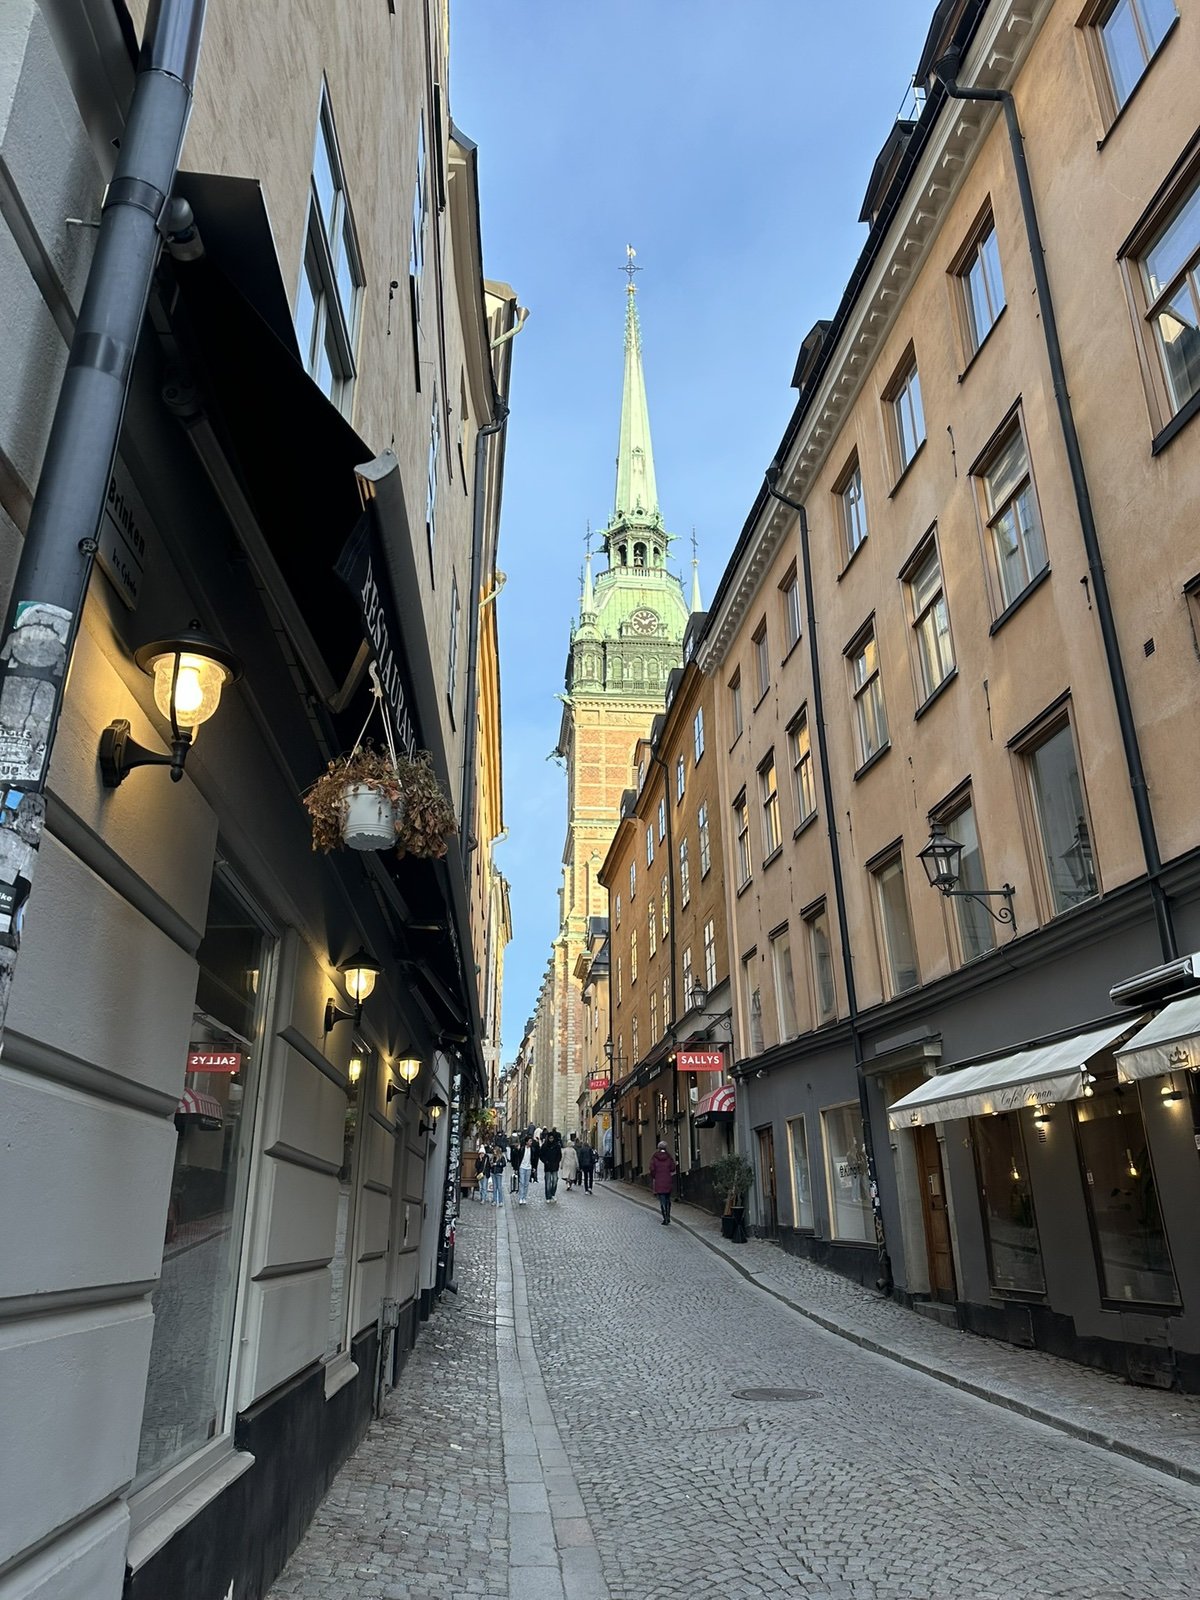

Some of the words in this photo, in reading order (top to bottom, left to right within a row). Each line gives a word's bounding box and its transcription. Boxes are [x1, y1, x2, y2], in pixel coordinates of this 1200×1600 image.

[108, 477, 145, 558] Brinken
[0, 891, 13, 902] ke
[681, 1055, 720, 1064] SALLYS
[590, 1080, 606, 1088] PIZZA
